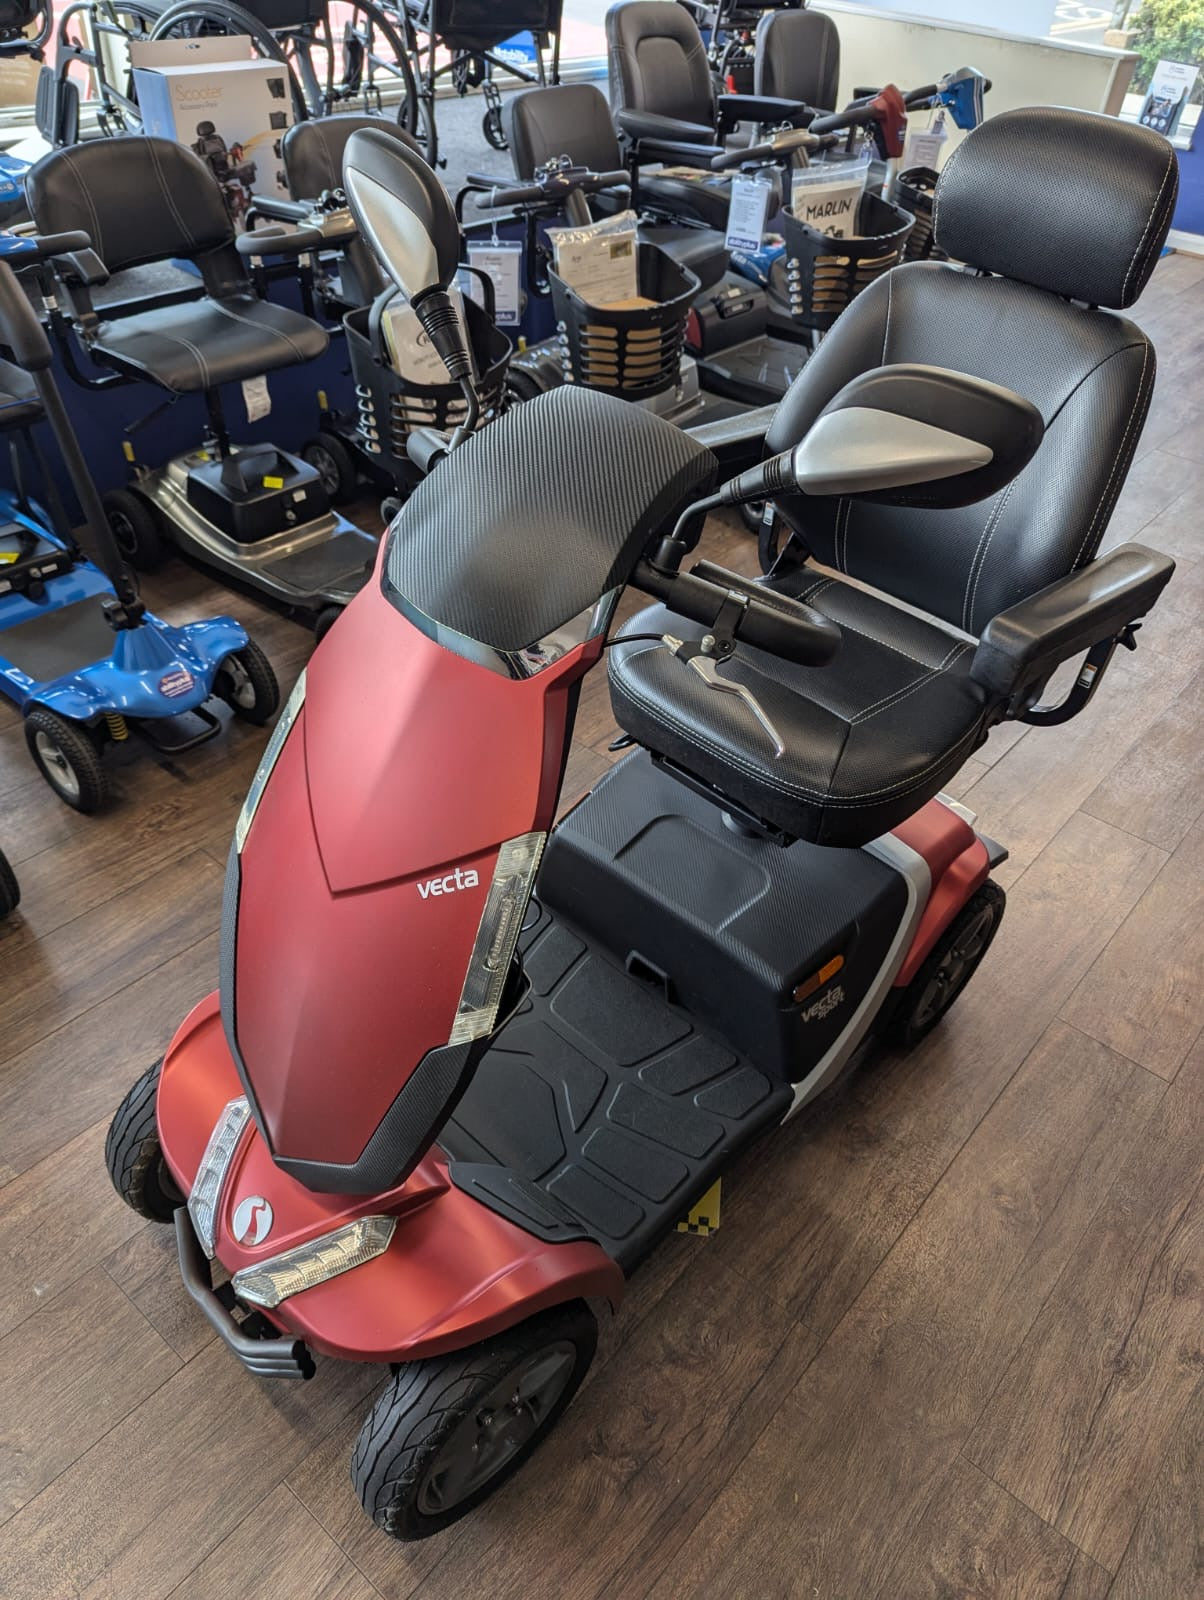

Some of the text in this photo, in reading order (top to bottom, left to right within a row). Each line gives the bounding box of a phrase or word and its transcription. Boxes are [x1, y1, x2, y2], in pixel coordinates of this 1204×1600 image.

[175, 84, 223, 101] Scooter
[806, 198, 853, 221] MARLIN
[416, 867, 480, 900] vecta
[801, 985, 843, 1023] vecta
